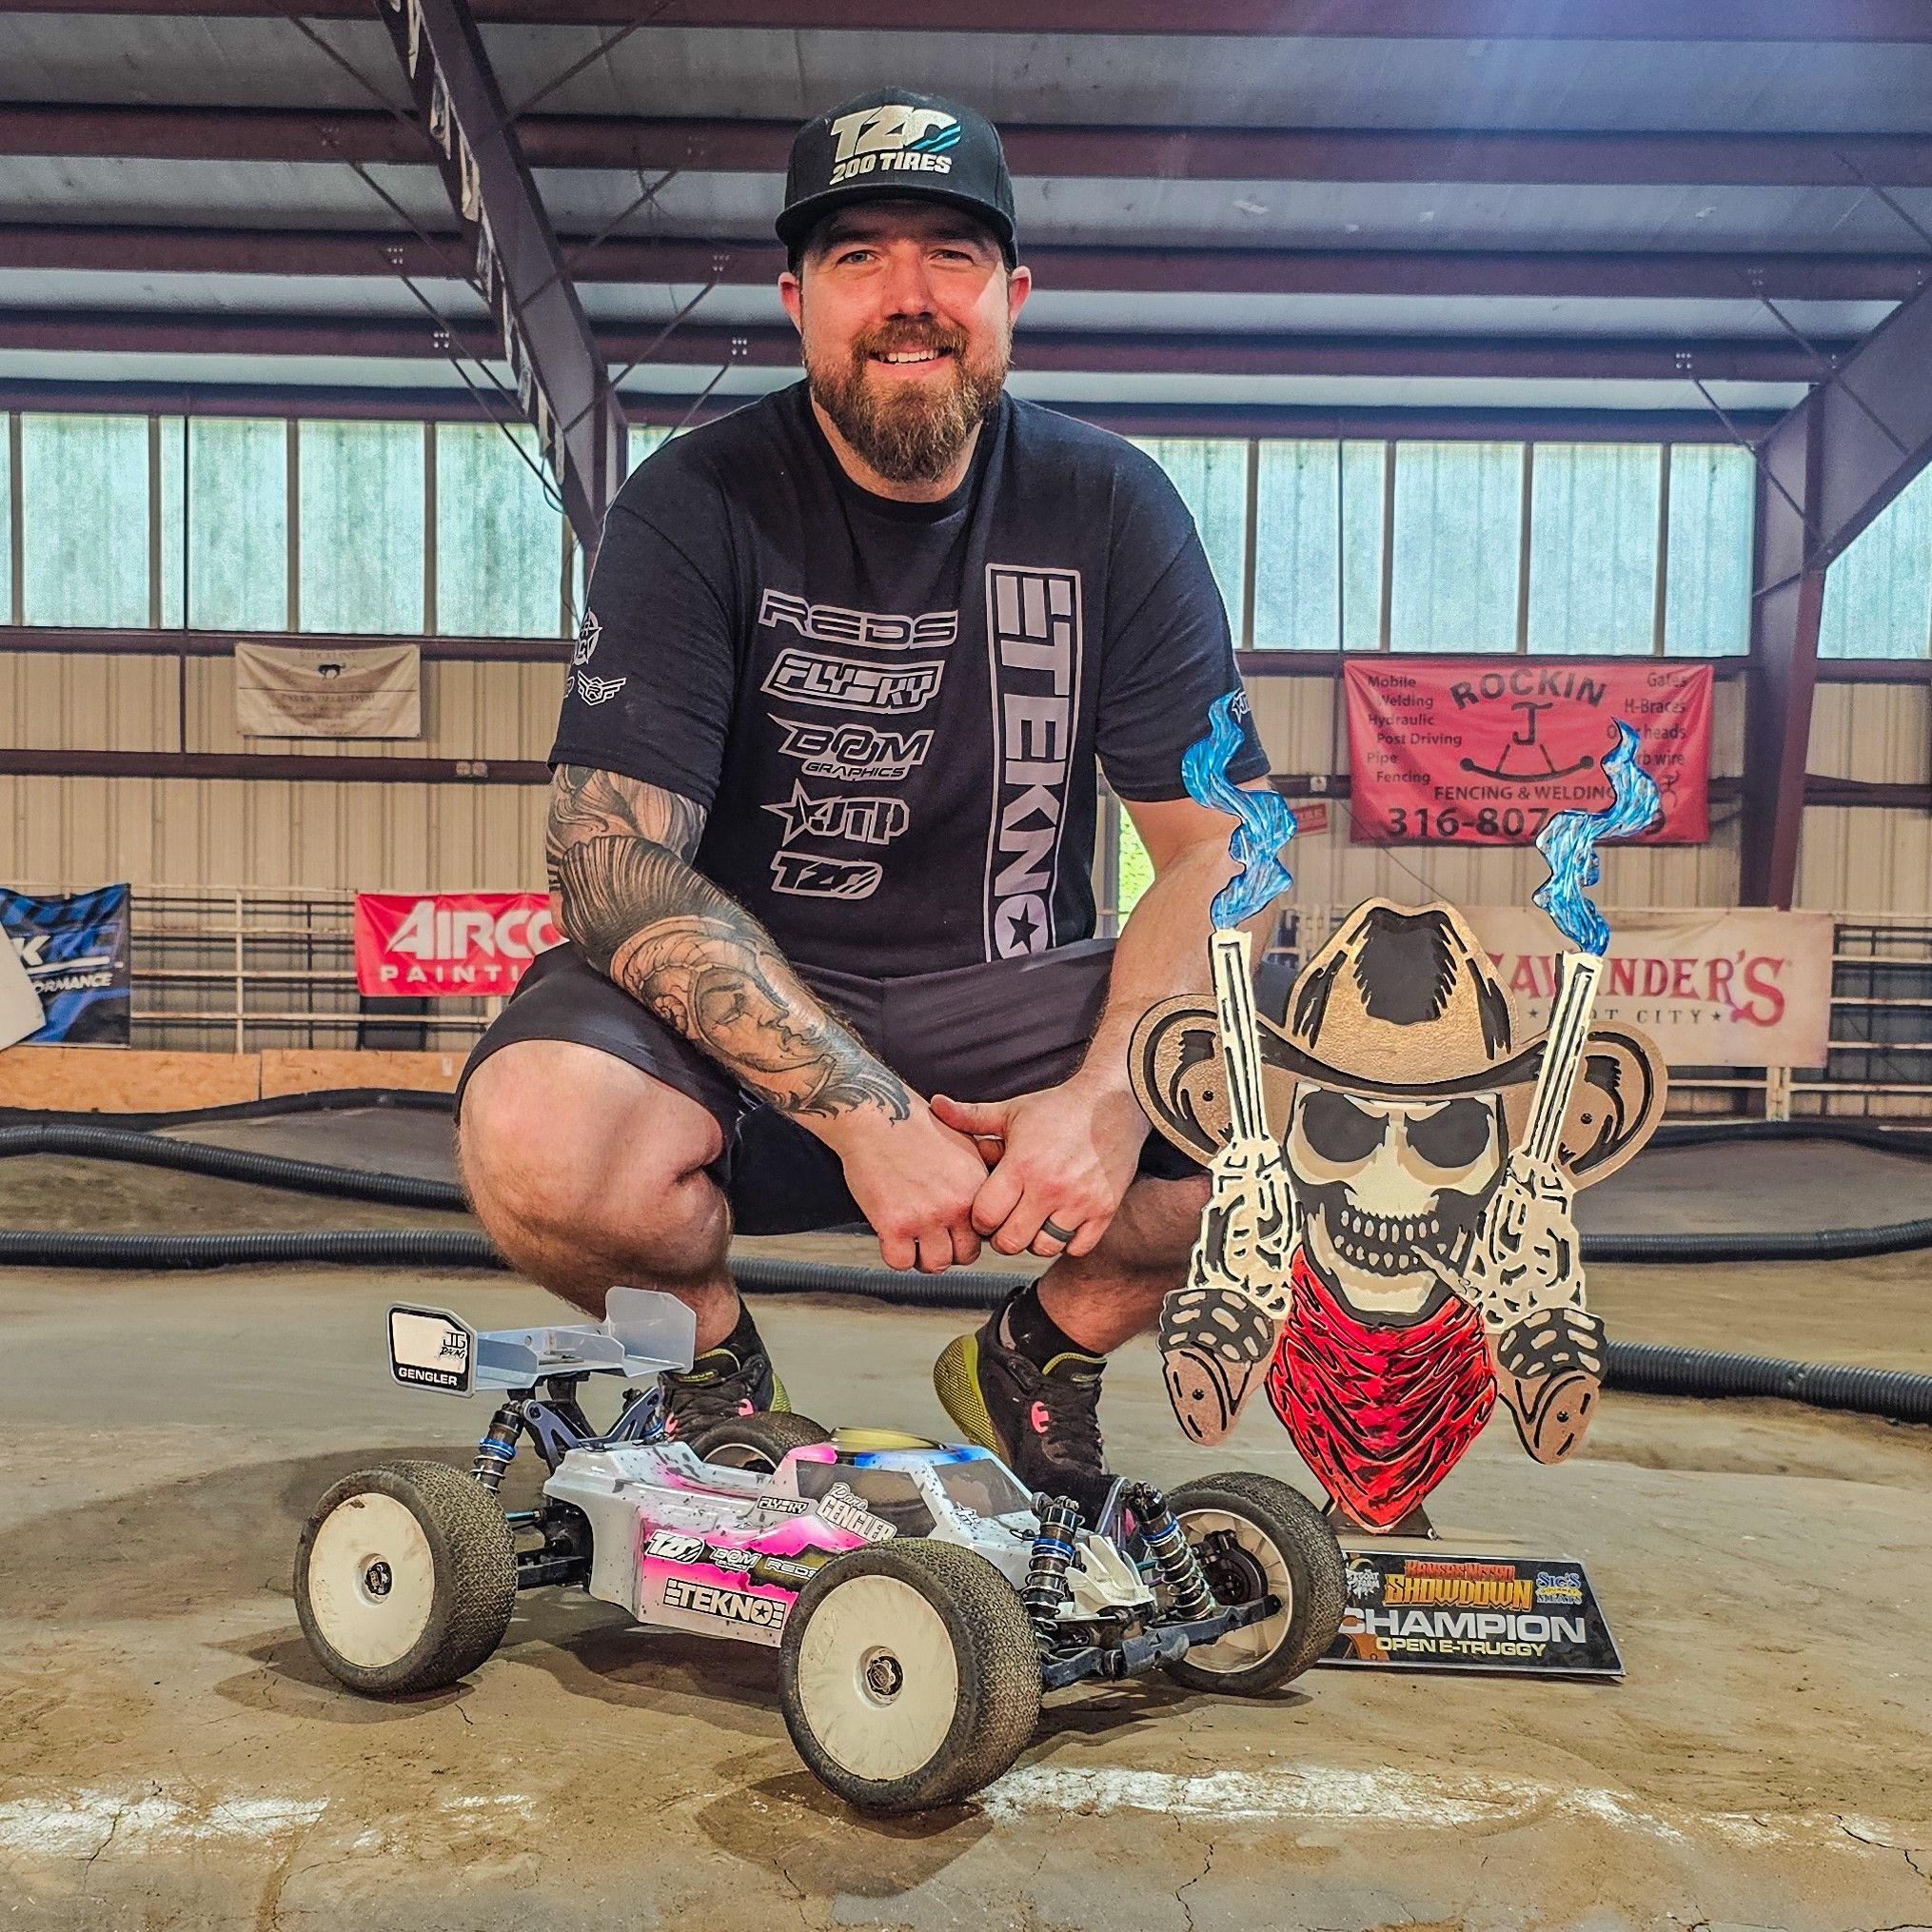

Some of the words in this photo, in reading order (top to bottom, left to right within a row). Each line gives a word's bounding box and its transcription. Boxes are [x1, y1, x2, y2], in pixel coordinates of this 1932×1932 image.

[829, 154, 877, 186] 200
[879, 151, 952, 174] TIRES
[759, 588, 958, 651] REDS
[773, 656, 937, 706] FLYSKY
[1368, 675, 1416, 688] Mobile
[1449, 668, 1607, 711] ROCKIN
[1625, 698, 1686, 713] H-Braces
[1369, 714, 1435, 728] Hydraulic
[1377, 732, 1406, 745] Post
[1410, 732, 1463, 748] Driving
[1367, 752, 1398, 766] Pipe
[1654, 748, 1686, 766] wire
[805, 761, 906, 779] GRAPHICS
[1376, 771, 1431, 786] Fencing
[1434, 785, 1513, 800] FENCING
[1518, 785, 1529, 800] &
[382, 965, 521, 983] PAINTI
[1636, 1009, 1703, 1024] CITY
[398, 1366, 459, 1387] GENGLER
[816, 1494, 897, 1543] GENGLER
[1384, 1573, 1533, 1613] SHOWDOWN
[1337, 1606, 1587, 1644] CHAMPION
[1375, 1637, 1436, 1653] OPEN
[1439, 1639, 1548, 1657] E-TRUGGY
